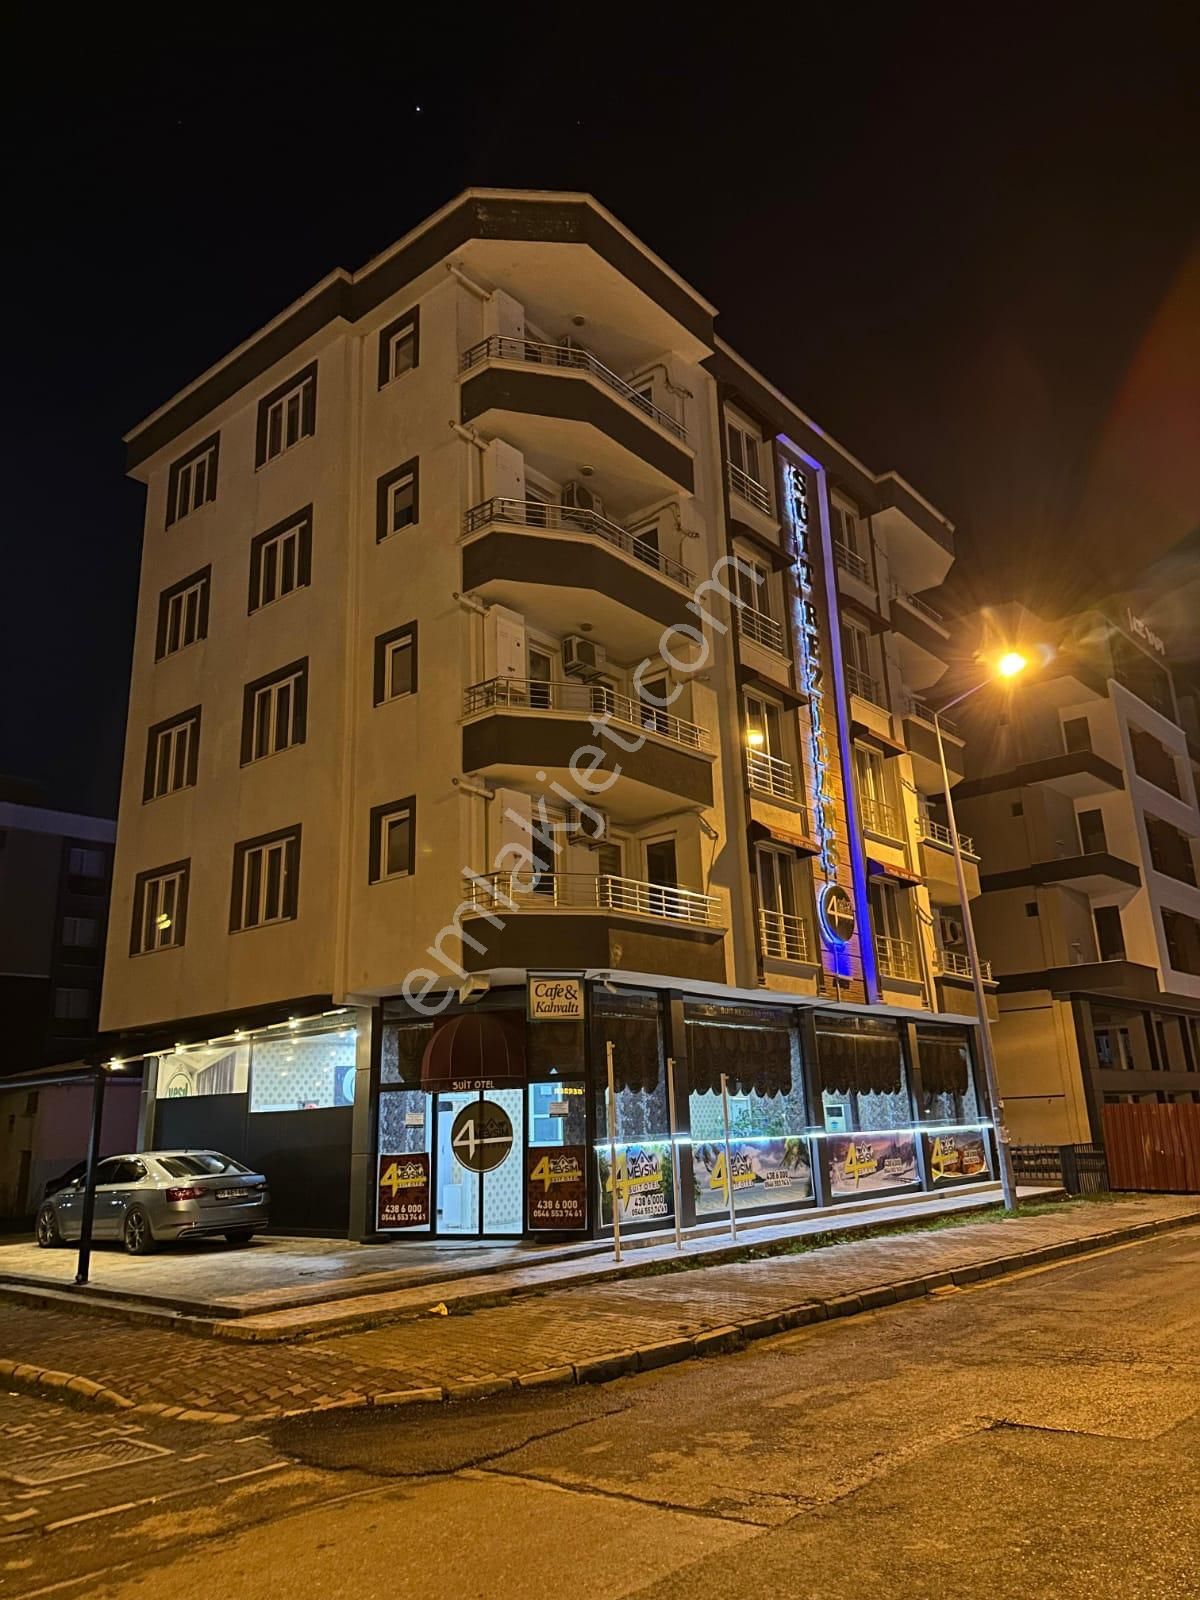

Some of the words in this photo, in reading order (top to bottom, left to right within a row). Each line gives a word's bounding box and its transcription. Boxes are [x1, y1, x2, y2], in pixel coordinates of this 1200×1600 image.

[474, 1079, 495, 1089] OTEL
[384, 1204, 400, 1213] 438
[401, 1204, 407, 1213] 6
[407, 1204, 423, 1213] 000
[537, 1200, 553, 1209] 438
[554, 1200, 560, 1208] 6
[562, 1200, 578, 1208] 000
